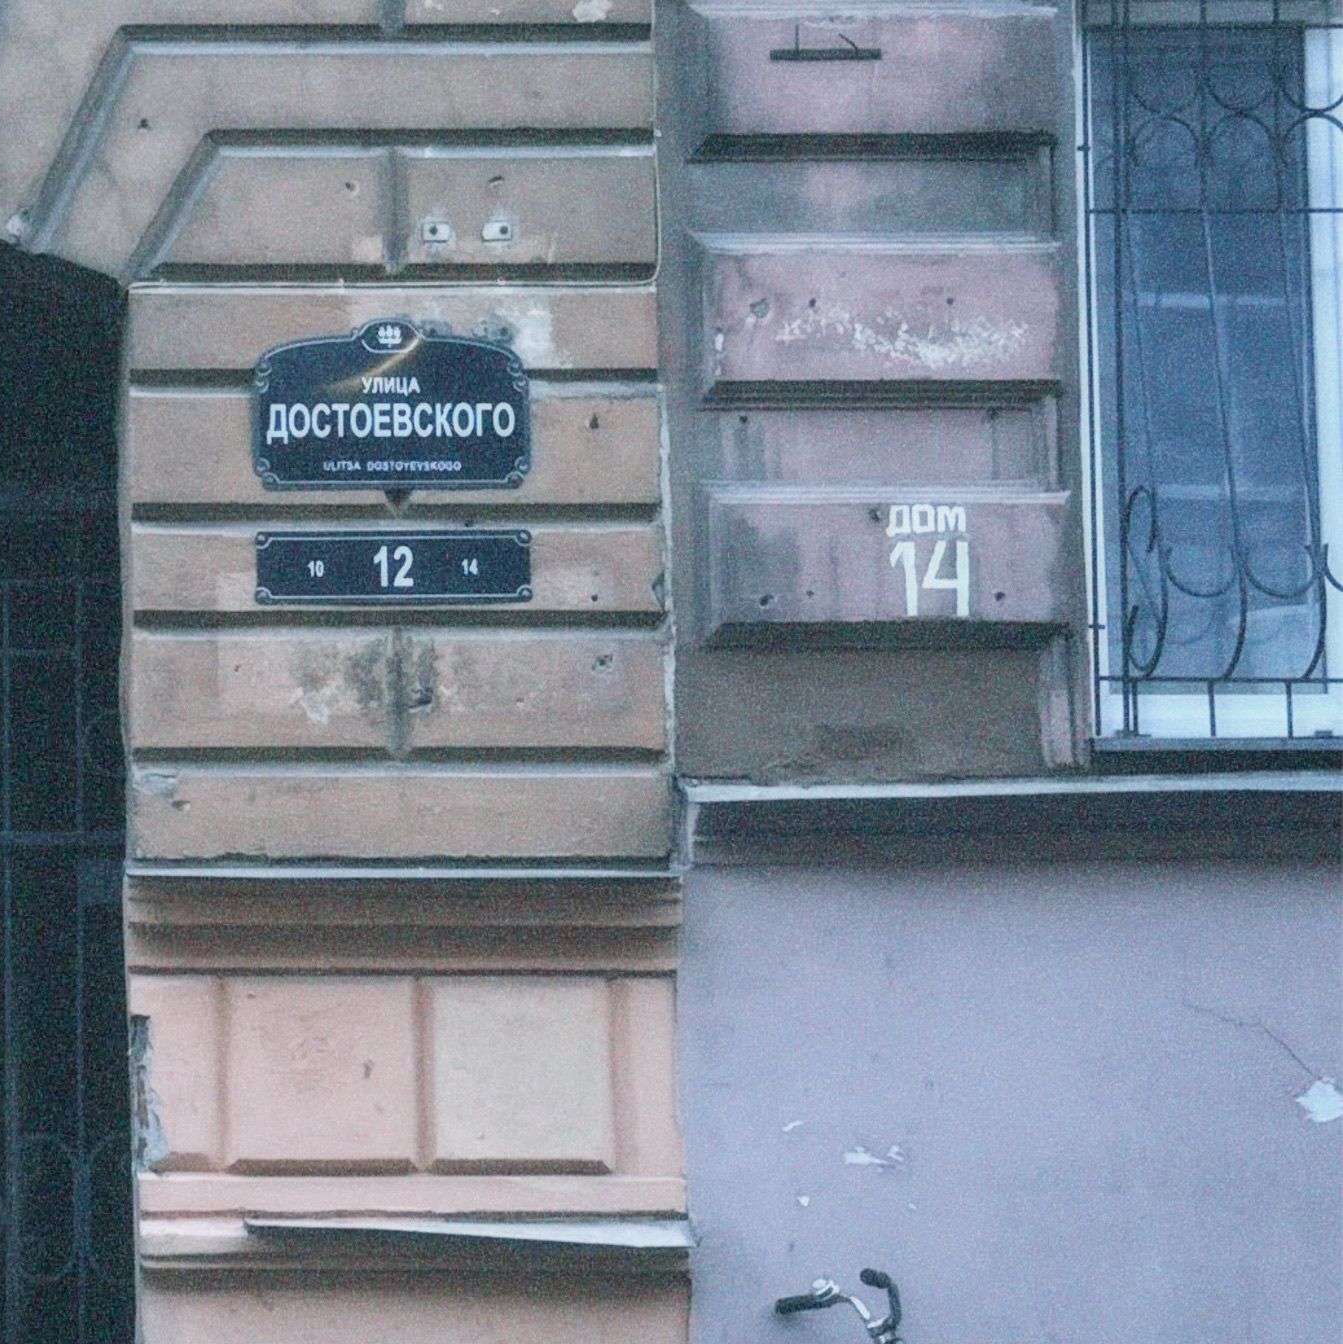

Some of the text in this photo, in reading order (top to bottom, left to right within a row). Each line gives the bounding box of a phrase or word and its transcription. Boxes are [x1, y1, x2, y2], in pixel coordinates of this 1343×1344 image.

[361, 376, 421, 396] УЛИЦА
[266, 401, 516, 445] ДОСТОЕВСКОГО
[885, 504, 967, 537] ДОМ
[307, 545, 479, 588] 10 12 14
[889, 540, 970, 617] 14
